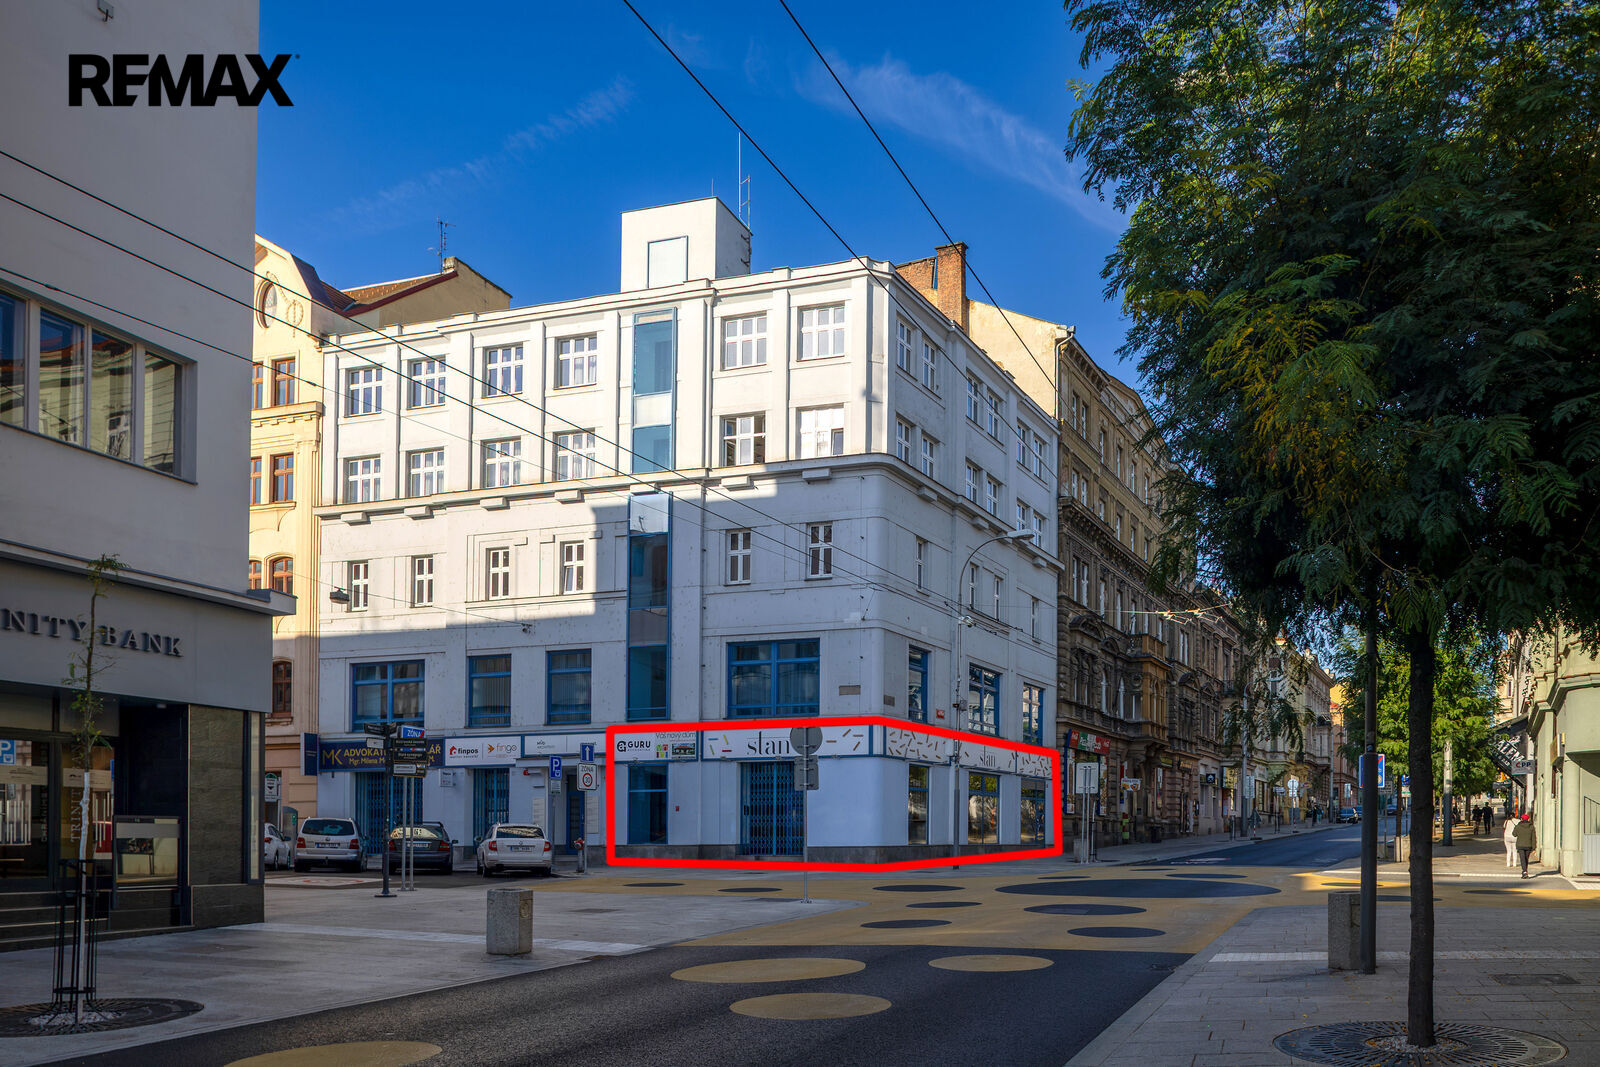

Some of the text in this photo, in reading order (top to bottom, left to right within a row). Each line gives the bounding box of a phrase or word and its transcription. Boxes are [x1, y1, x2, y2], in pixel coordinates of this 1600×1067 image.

[97, 624, 184, 657] BANK
[458, 747, 478, 756] finpos
[627, 740, 650, 749] GURU
[746, 731, 790, 755] stan
[323, 748, 343, 765] MK
